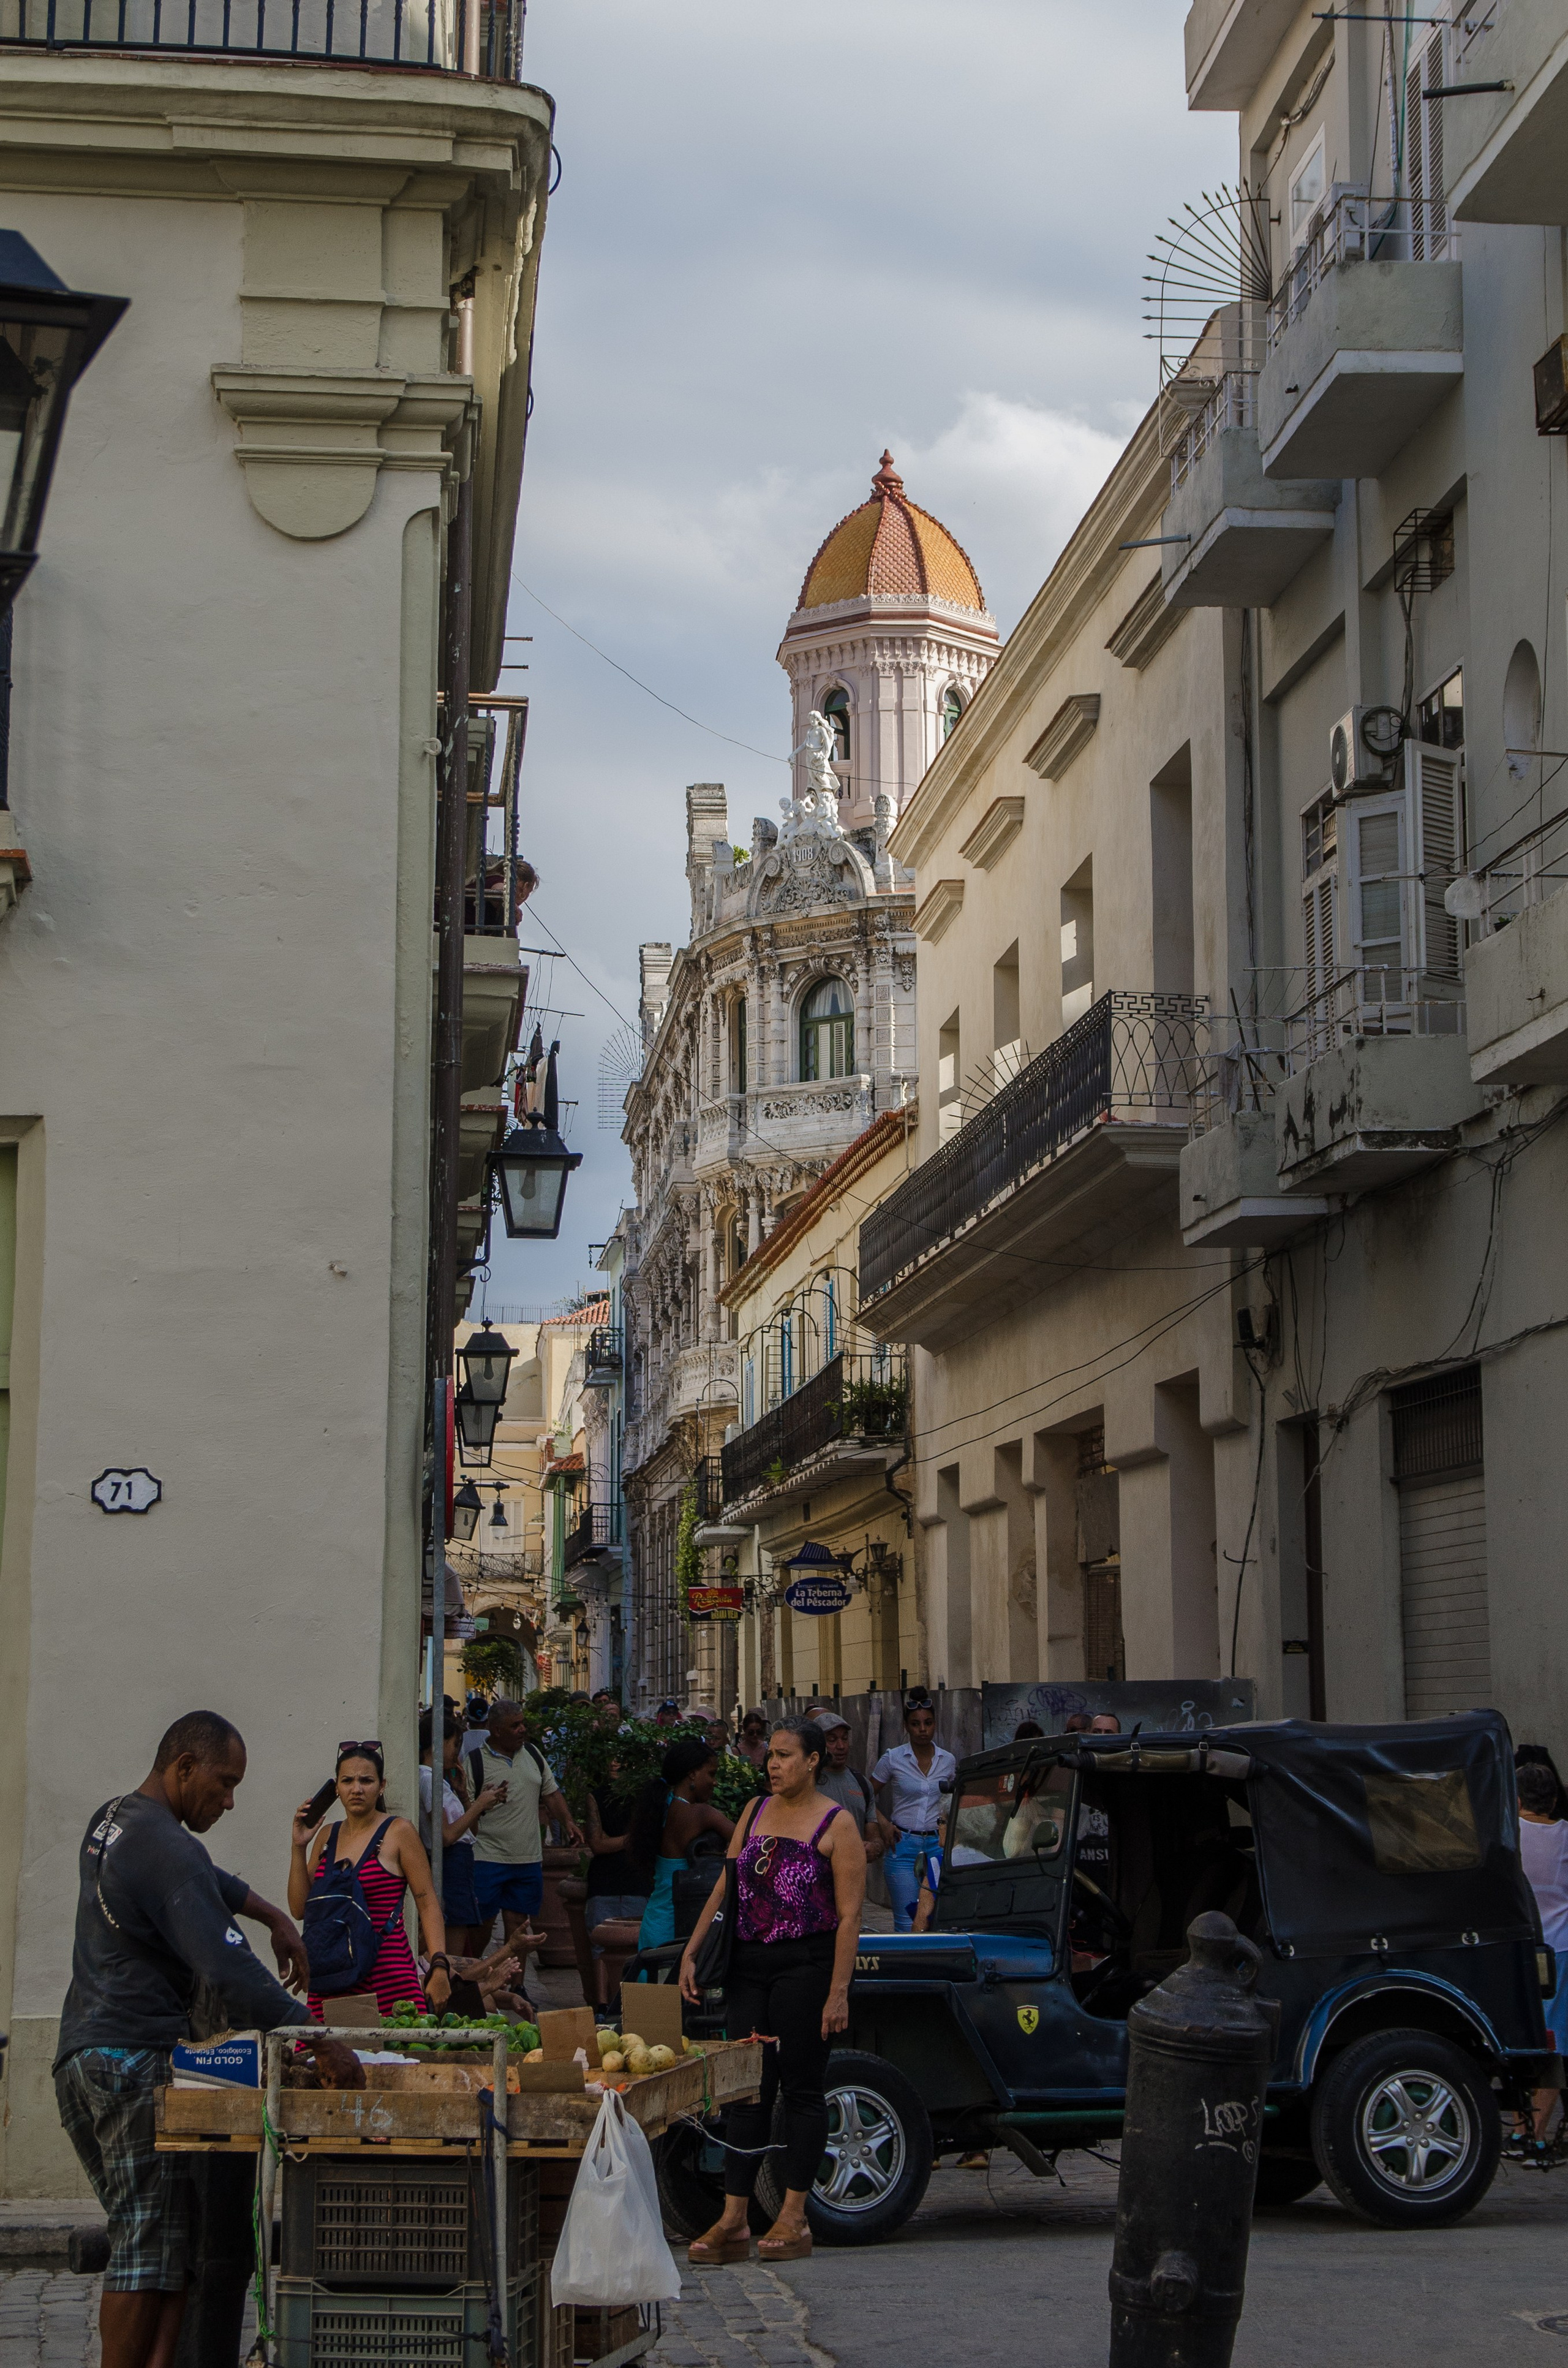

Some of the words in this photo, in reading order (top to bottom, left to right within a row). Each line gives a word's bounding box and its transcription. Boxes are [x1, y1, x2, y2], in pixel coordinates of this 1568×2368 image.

[793, 847, 813, 863] 1908
[110, 1481, 132, 1502] 71
[796, 1589, 805, 1597] La
[807, 1589, 842, 1597] Taberna
[791, 1597, 804, 1606] del
[807, 1597, 846, 1606] Pescador
[855, 1956, 881, 1971] LYS
[216, 2047, 252, 2056] Ecológico,
[214, 2056, 243, 2065] GOLD
[341, 2092, 394, 2130] 46
